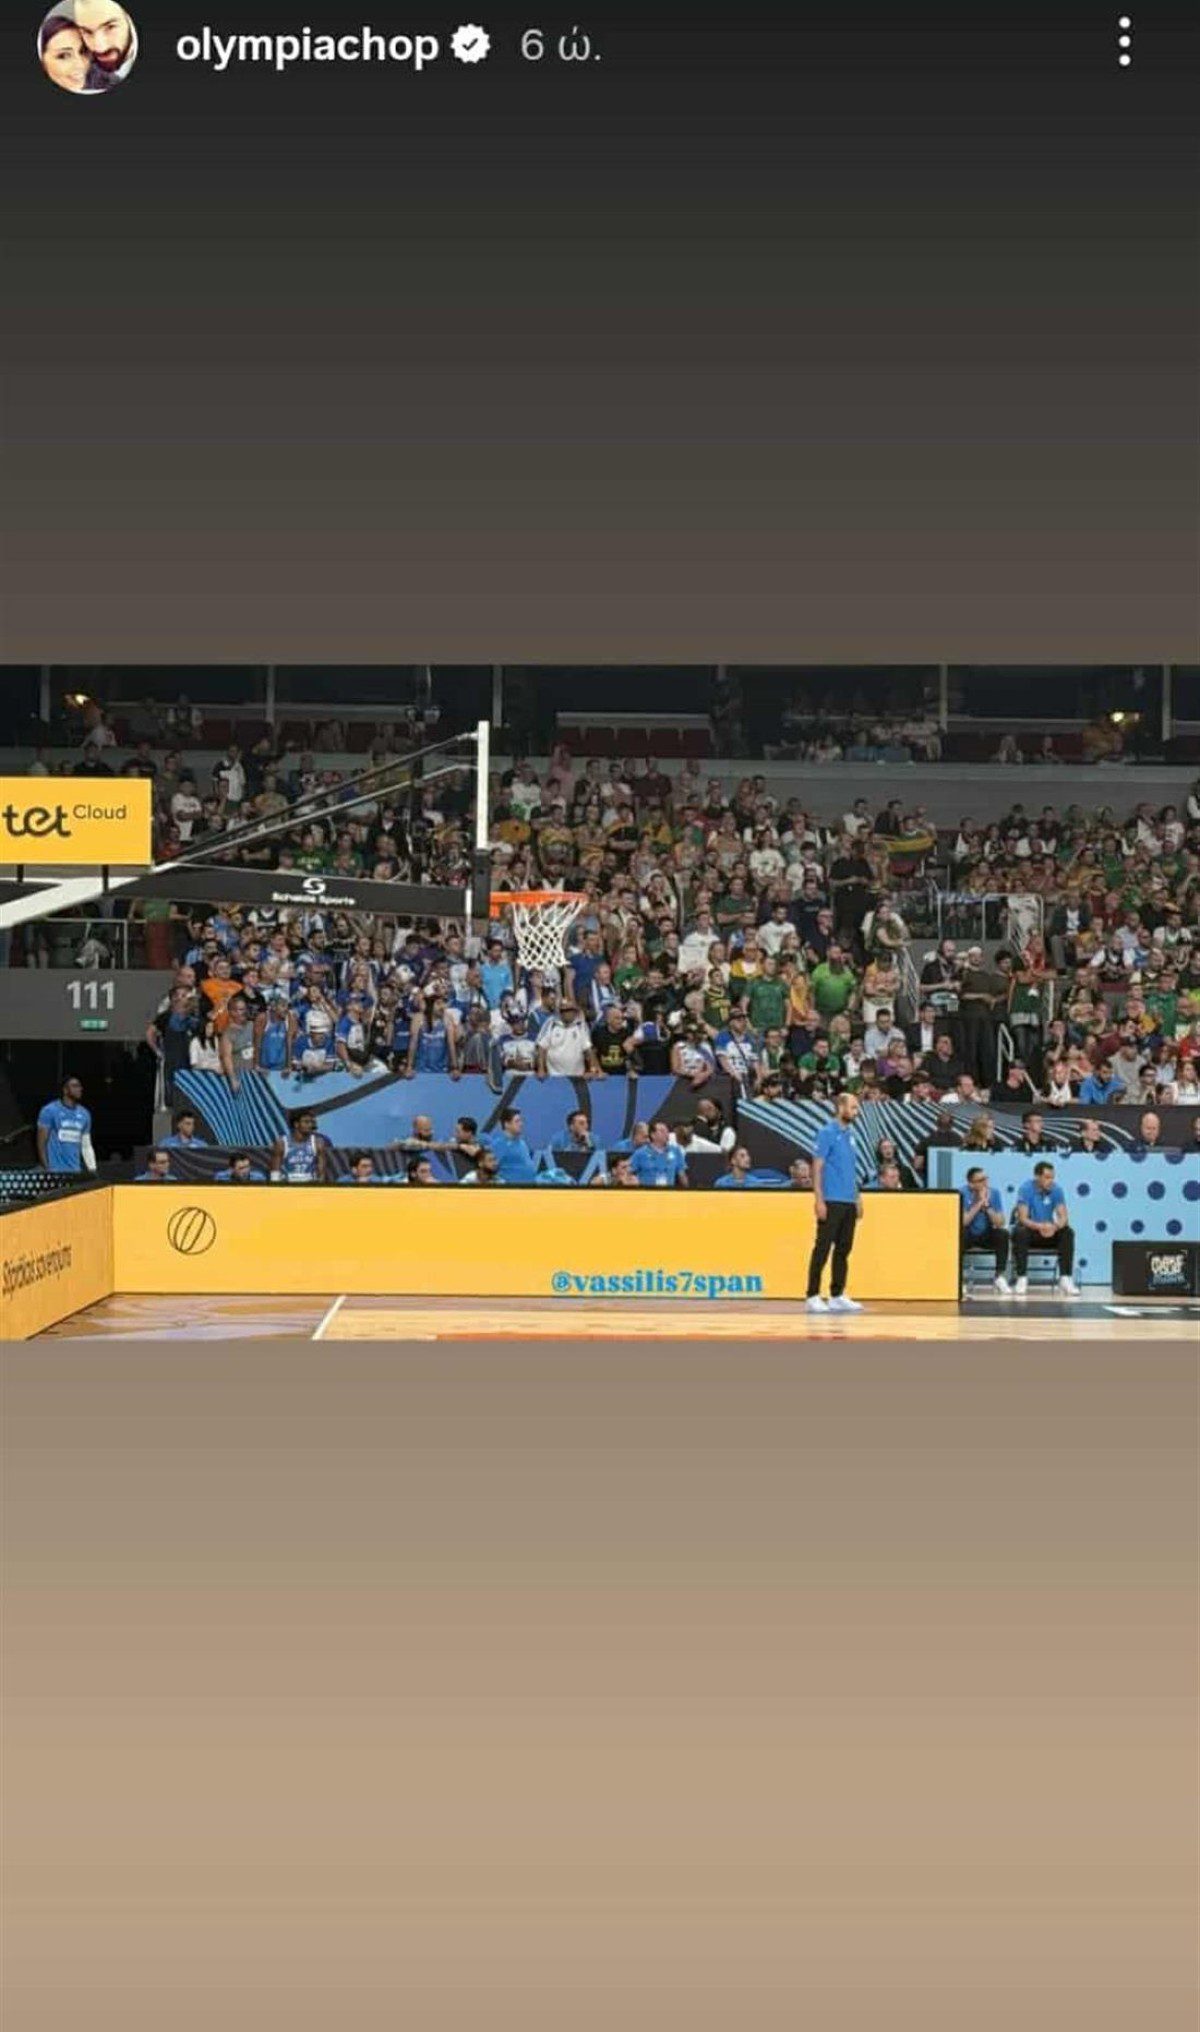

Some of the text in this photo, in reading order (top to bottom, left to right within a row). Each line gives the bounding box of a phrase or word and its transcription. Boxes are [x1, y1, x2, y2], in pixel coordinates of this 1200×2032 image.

[2, 804, 127, 838] tet Cloud
[66, 980, 115, 1010] 111
